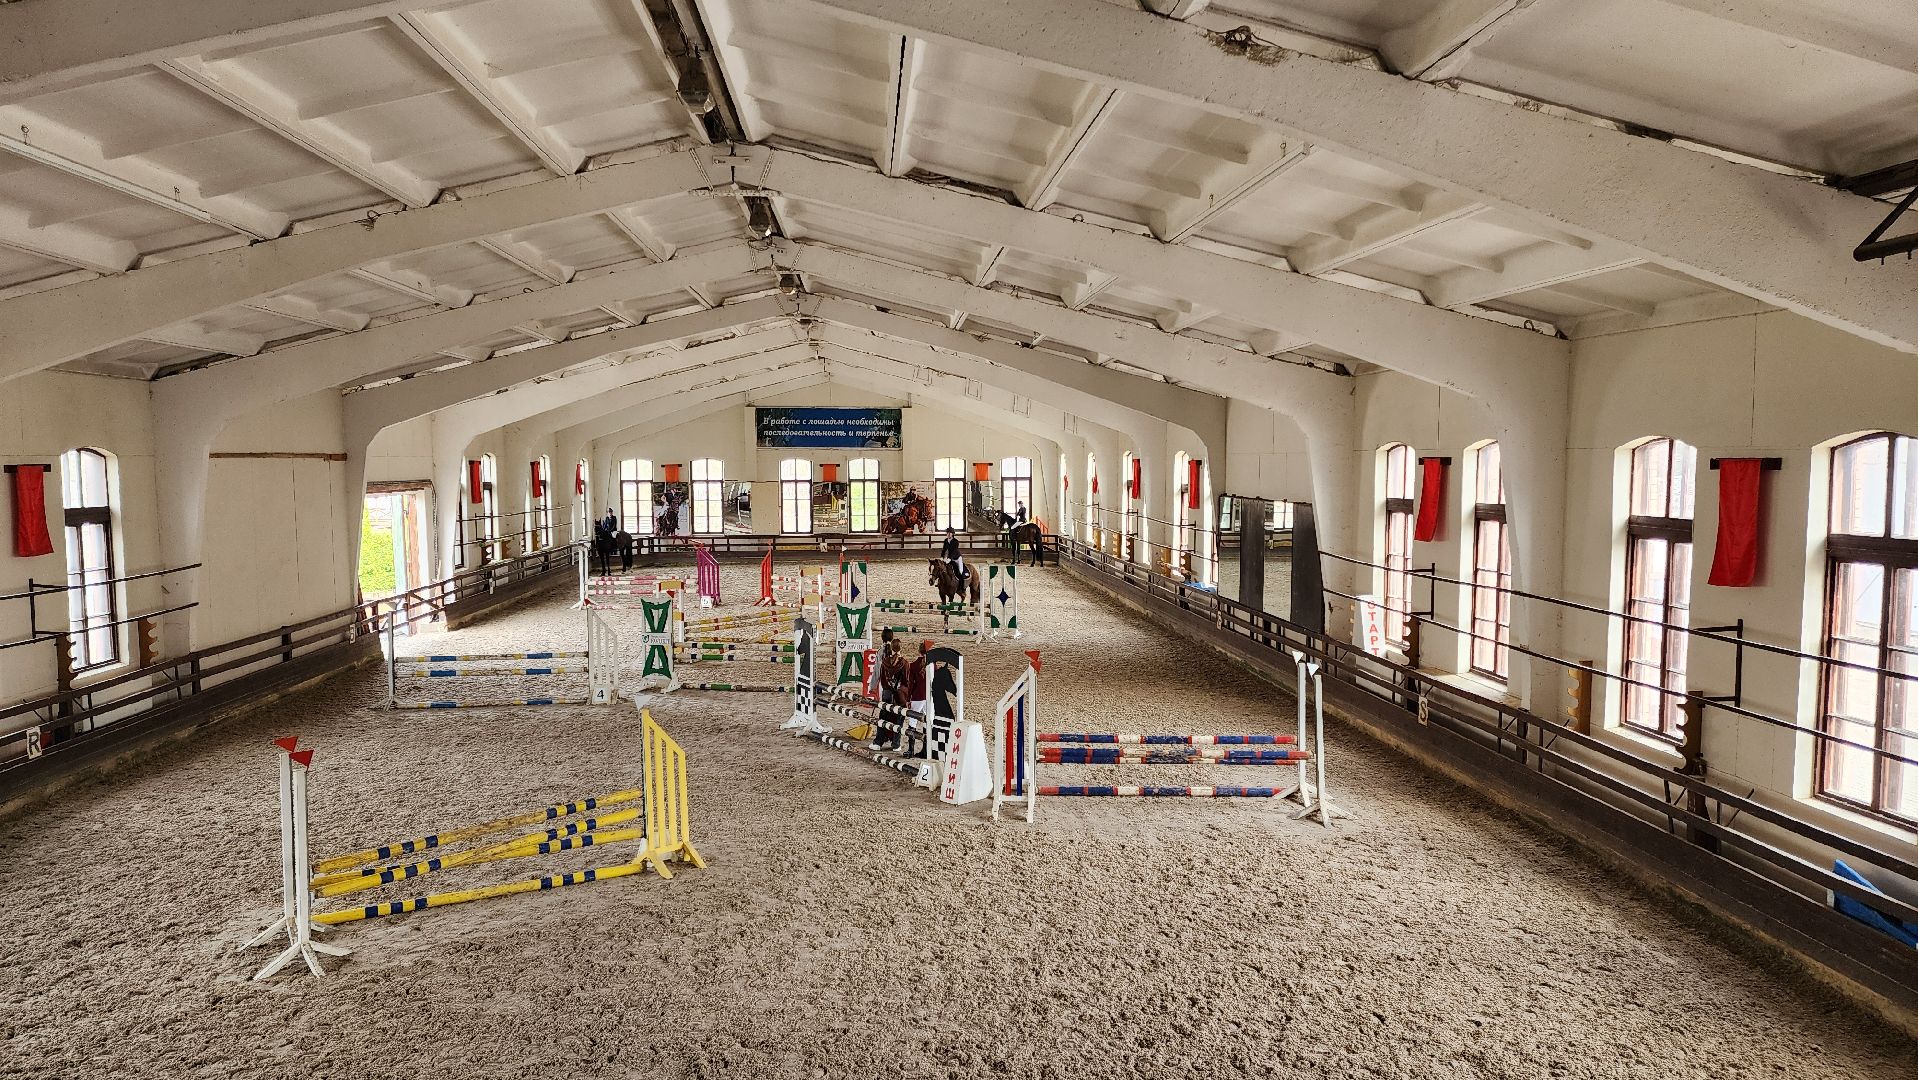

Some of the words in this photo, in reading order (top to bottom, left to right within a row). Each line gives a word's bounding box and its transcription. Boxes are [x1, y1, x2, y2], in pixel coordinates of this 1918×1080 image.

[770, 416, 801, 427] работе
[807, 416, 845, 426] лошадью
[846, 416, 895, 426] необходимы
[763, 427, 847, 437] последовательность
[596, 689, 605, 700] 4
[29, 732, 41, 755] R
[945, 727, 962, 800] ФИНИШ
[922, 767, 929, 781] 2
